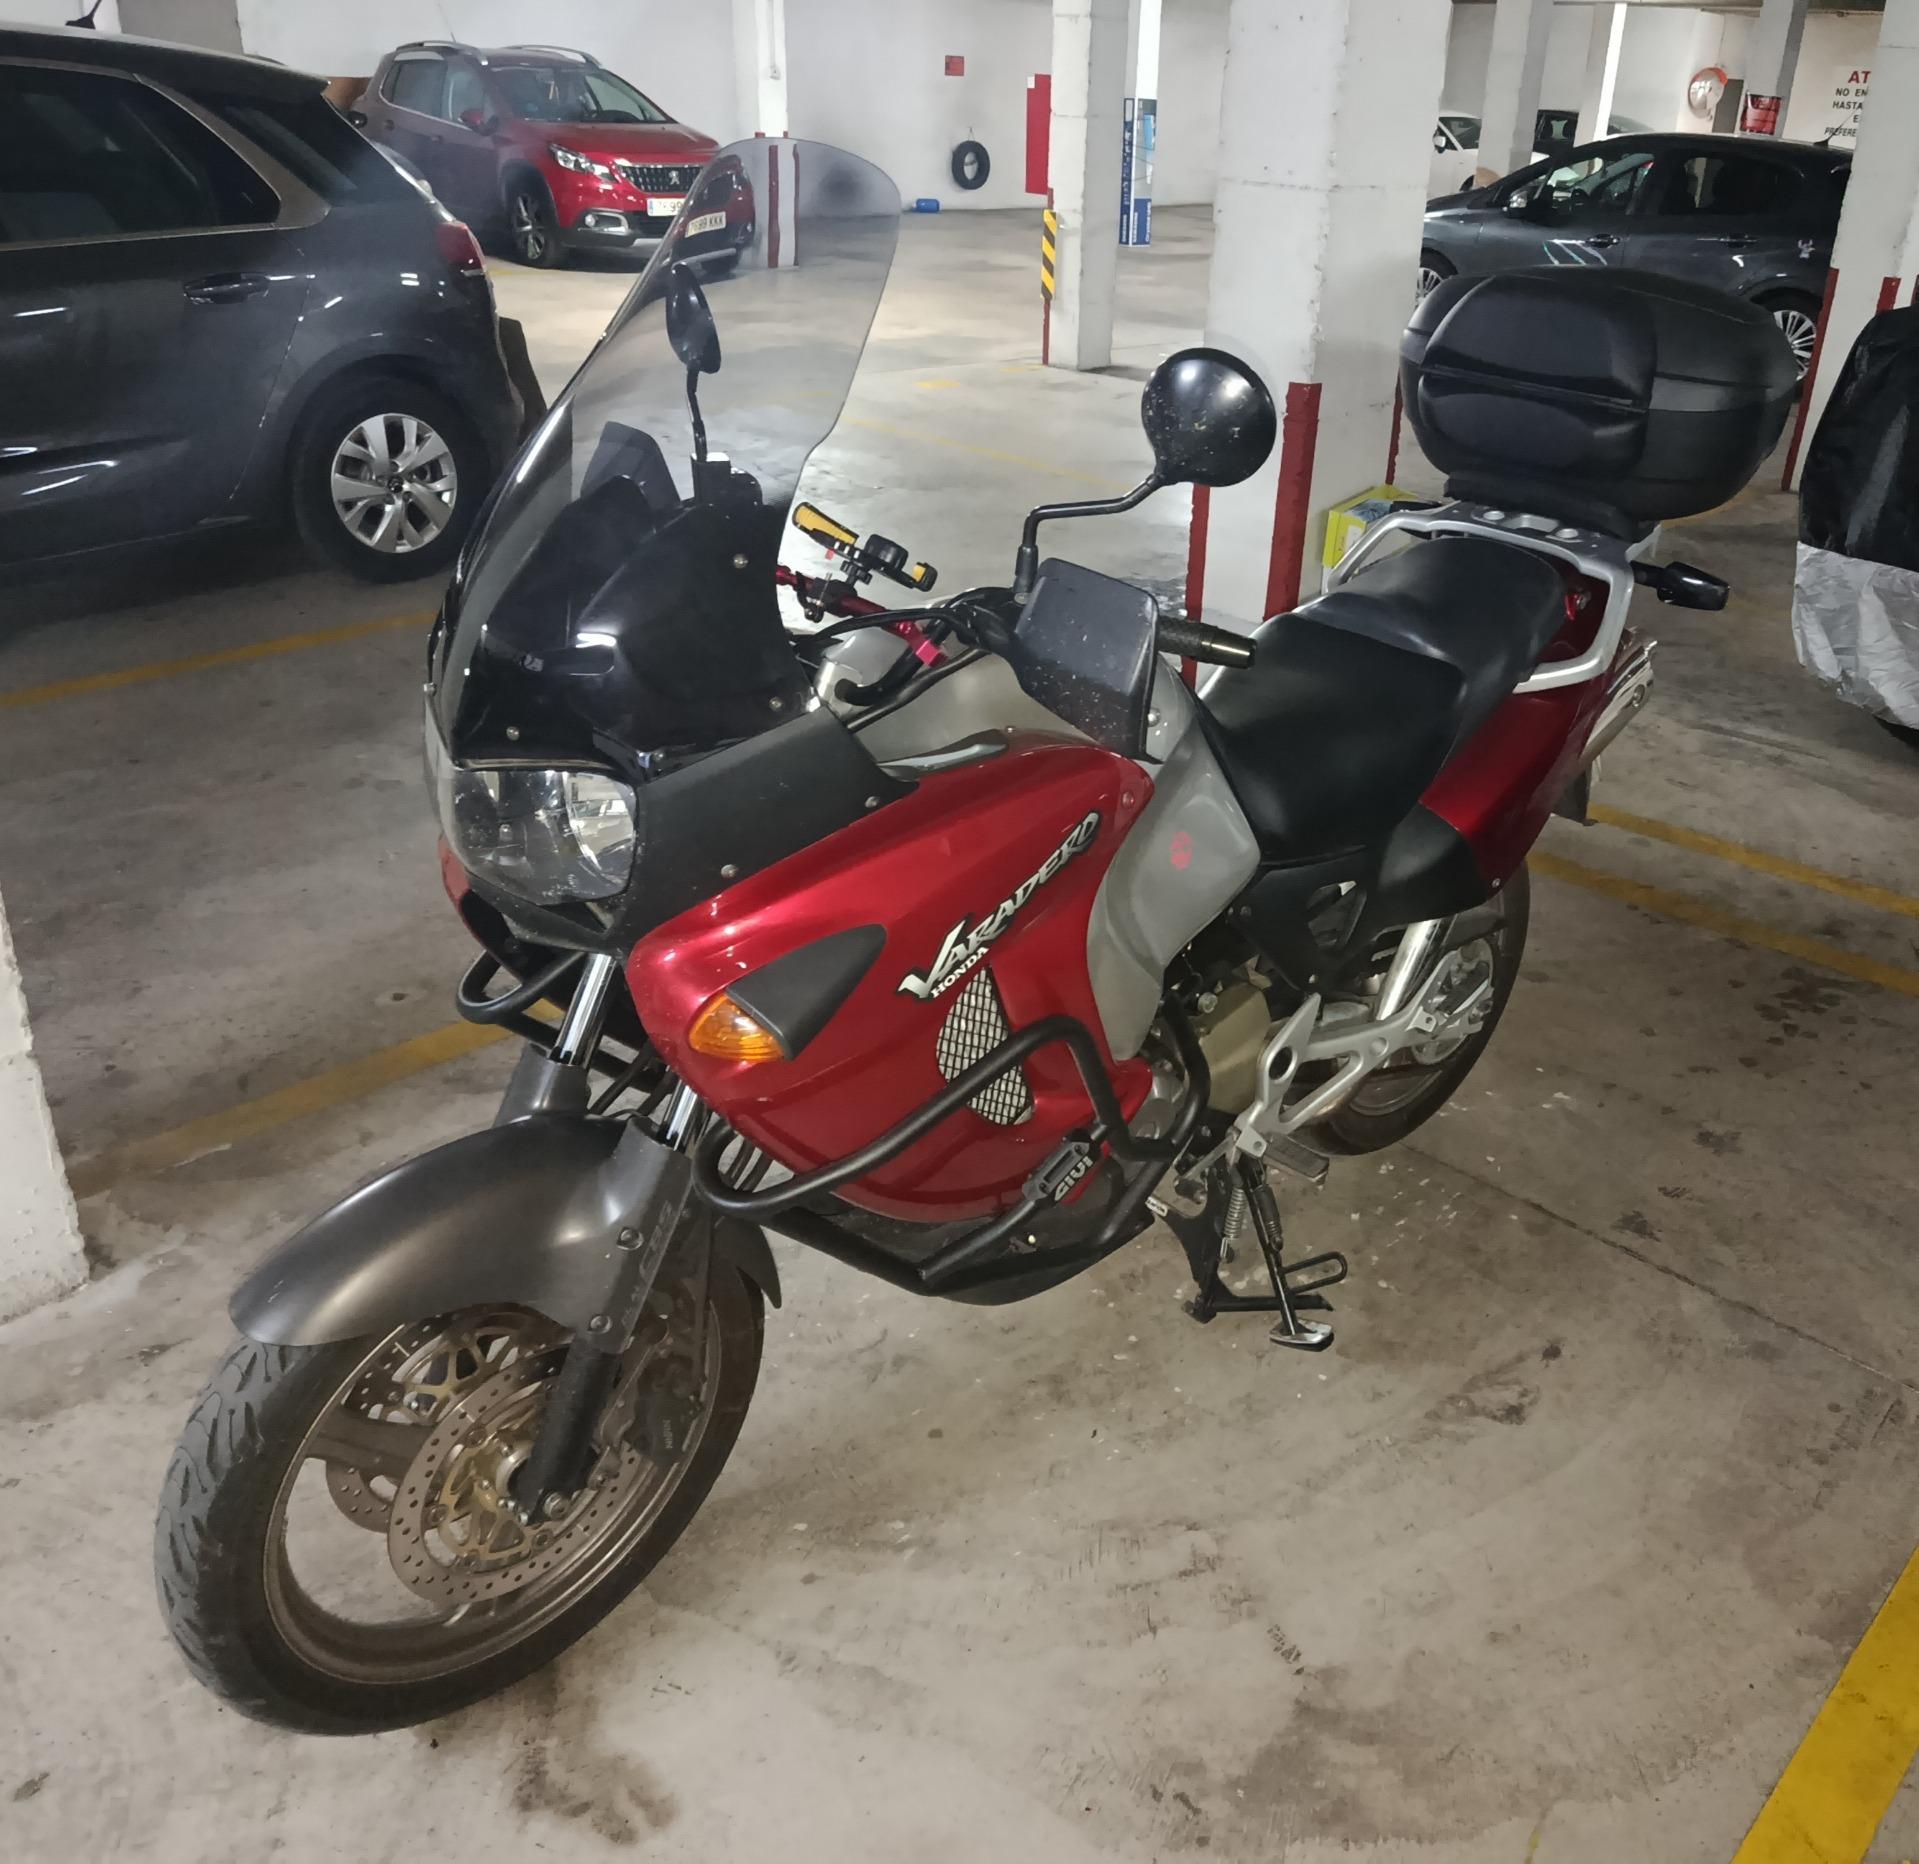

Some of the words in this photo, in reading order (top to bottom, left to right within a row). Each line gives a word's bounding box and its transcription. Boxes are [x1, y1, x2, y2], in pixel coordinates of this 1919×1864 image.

[1835, 87, 1850, 97] NO
[1847, 70, 1871, 84] AT
[1832, 100, 1863, 110] HASTA
[896, 811, 1101, 1000] VARADERO
[930, 946, 990, 998] HONDA
[1054, 1155, 1094, 1202] GIVI
